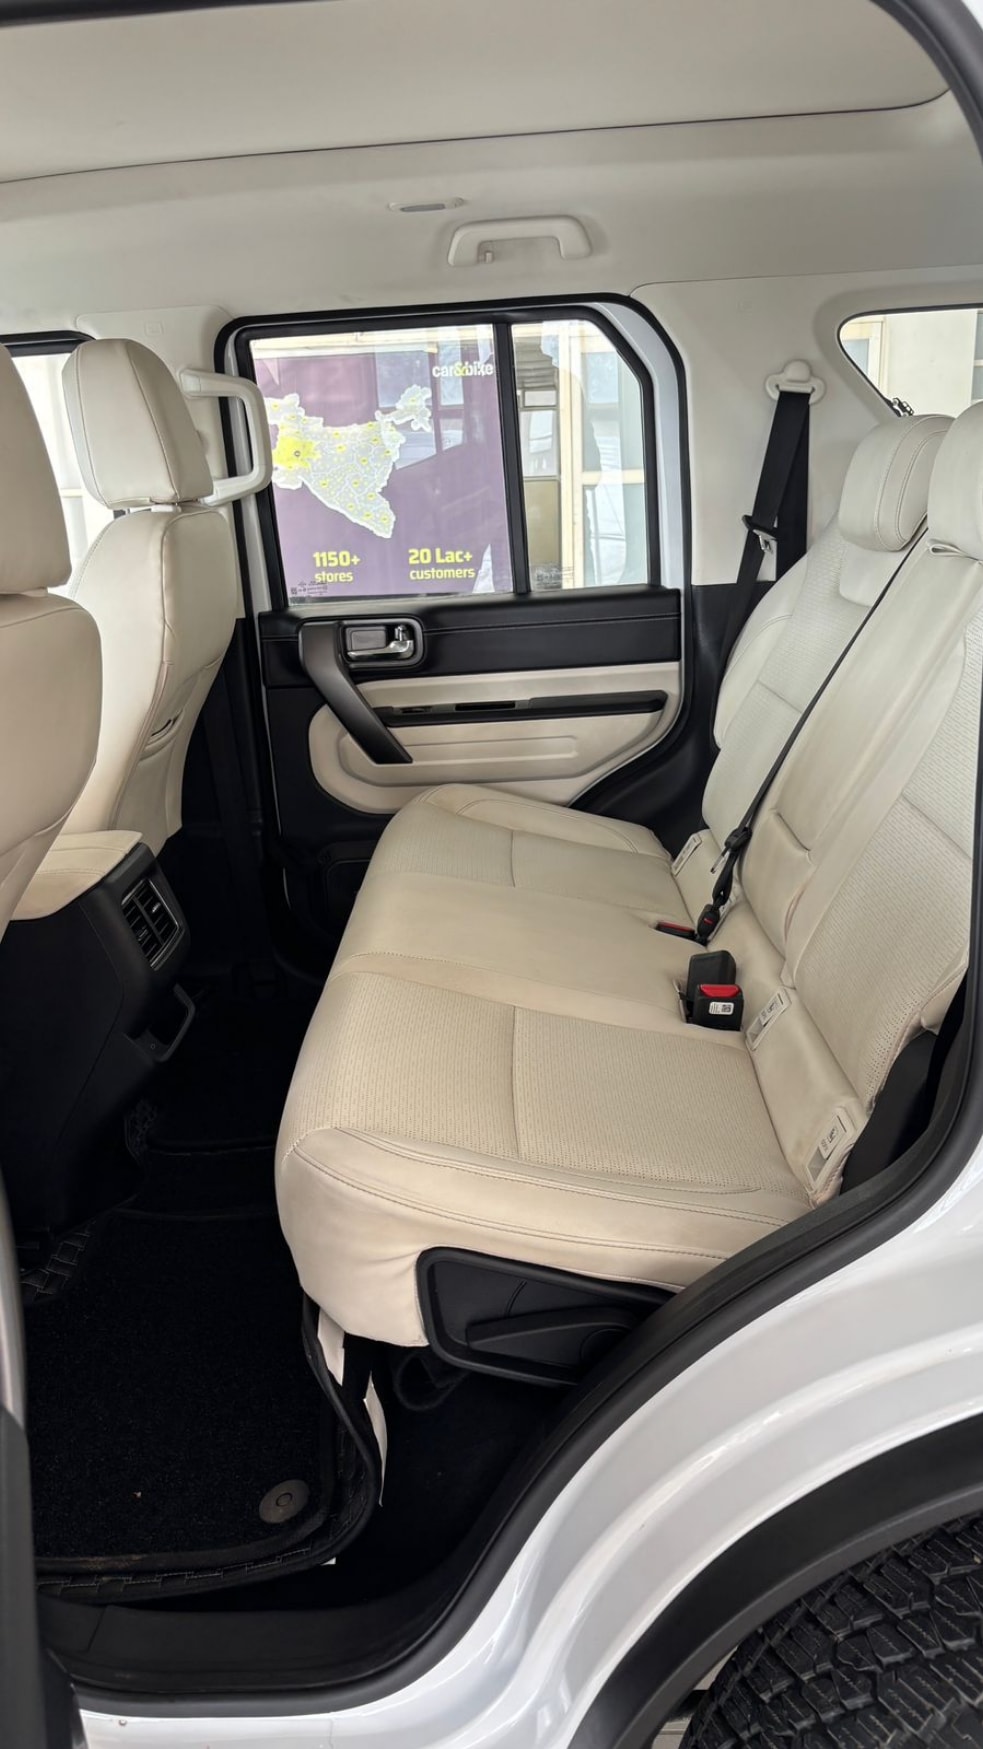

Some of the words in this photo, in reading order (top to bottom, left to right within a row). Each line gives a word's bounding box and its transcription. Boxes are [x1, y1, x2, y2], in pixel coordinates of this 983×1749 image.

[432, 360, 494, 377] car&bike
[313, 550, 361, 567] 1150+
[408, 547, 432, 565] 20
[435, 547, 473, 563] Lac+
[314, 571, 354, 583] stores
[409, 567, 476, 580] customers
